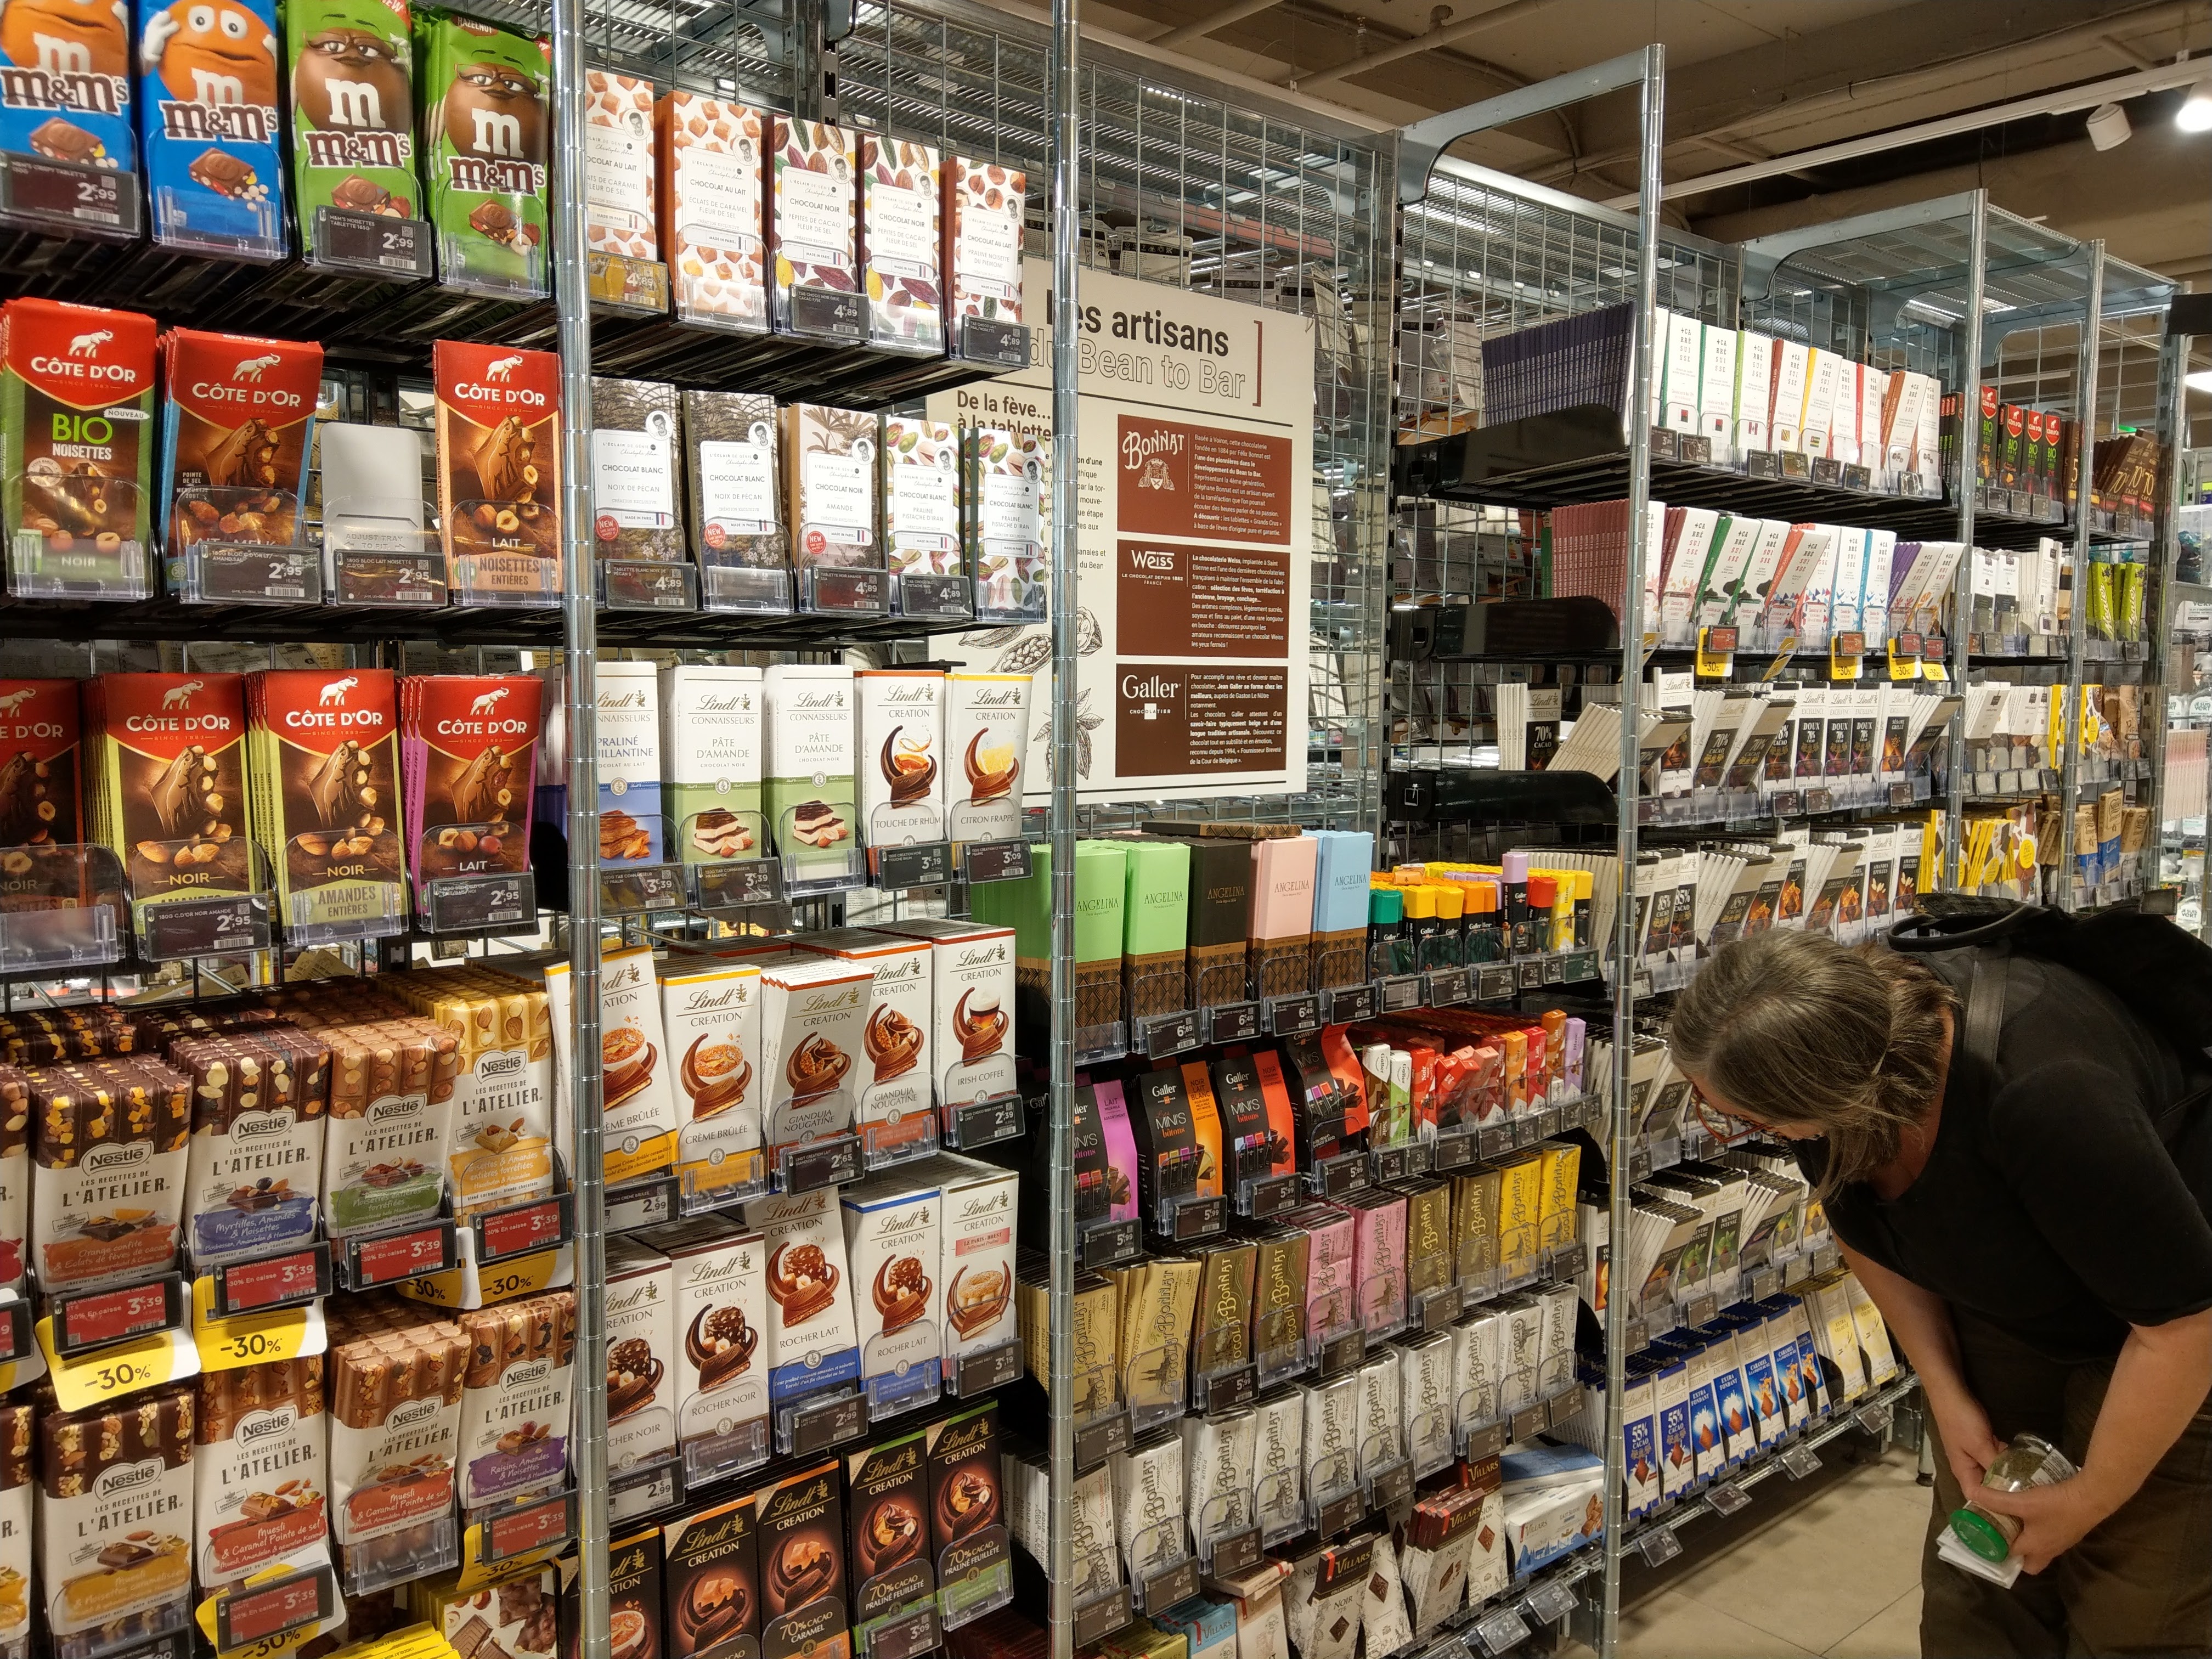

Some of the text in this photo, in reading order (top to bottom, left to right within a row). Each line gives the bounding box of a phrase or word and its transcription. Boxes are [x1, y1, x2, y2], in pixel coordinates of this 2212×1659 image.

[457, 16, 493, 33] HAZELNUT
[690, 178, 722, 191] CHOCOLAT
[732, 187, 746, 196] LAIT
[689, 195, 710, 206] ÉCLATS
[721, 200, 747, 213] CARAMEL
[790, 198, 840, 213] CHOCOLAT NOIR
[330, 221, 358, 230] TABLETTE
[348, 217, 375, 226] NOISETTES
[1113, 310, 1228, 357] artisans
[31, 357, 84, 377] CÔTE
[1078, 338, 1245, 399] Bean to Bar
[455, 383, 500, 402] CÔTE
[957, 391, 978, 408] De
[984, 393, 997, 412] la
[108, 409, 144, 419] NOUVEAU
[53, 414, 112, 443] BIO
[53, 443, 112, 459] NOISETTES
[1122, 430, 1184, 470] BONNAT
[1214, 437, 1228, 445] Voiron,
[1241, 440, 1267, 449] chocolaterie
[2008, 438, 2017, 453] BIO
[602, 465, 640, 473] CHOCOLAT
[639, 483, 659, 492] PÉCAN
[599, 521, 614, 529] NEW
[493, 538, 521, 548] LAIT
[480, 557, 538, 573] NOISETTES
[1131, 550, 1175, 569] Weiss
[492, 573, 528, 586] ENTIÈRES
[1122, 675, 1178, 698] Galler
[697, 694, 739, 710] Lindt
[286, 709, 335, 726] CÔTE
[692, 716, 754, 725] CONNAISSEURS
[889, 709, 930, 718] CREATION
[1803, 723, 1820, 731] DOUX
[712, 737, 735, 747] PÂTE
[697, 749, 749, 758] D'AMANDE
[875, 820, 907, 828] TOUCHE
[919, 817, 941, 826] RHUM
[961, 813, 1014, 825] CITRON FRAPPÉ
[327, 866, 364, 877] NOIR
[459, 861, 487, 872] LAIT
[1274, 880, 1310, 893] ANGELINA
[318, 887, 376, 905] AMANDES
[1144, 891, 1184, 905] ANGELINA
[328, 902, 368, 916] ENTIÈRES
[957, 1069, 1005, 1086] IRISH COFFEE
[1152, 1085, 1177, 1097] Galler
[1155, 1113, 1186, 1130] MINI'S
[686, 1124, 748, 1144] CRÈME BRÛLÉE
[1163, 1126, 1185, 1138] bâtons
[90, 1149, 144, 1166] Nestlé
[99, 1173, 136, 1184] RECETTES
[63, 1177, 165, 1206] L'ATELIER
[216, 1212, 295, 1233] Myrtilles, Amandes
[230, 1223, 279, 1238] & Noisettes
[878, 1336, 927, 1357] ROCHER LAIT
[1719, 1381, 1737, 1392] FONDANT
[1720, 1376, 1737, 1386] EXTRA
[692, 1391, 756, 1417] ROCHER NOIR
[1668, 1409, 1683, 1426] 55%
[1669, 1425, 1684, 1435] CACAO
[1468, 1460, 1499, 1481] VILLARS
[258, 1521, 286, 1538] Muesli
[222, 1519, 320, 1560] & Caramel Pointe de sel
[1335, 1550, 1371, 1573] VILLARS
[1333, 1595, 1353, 1610] NOIR
[780, 1611, 833, 1640] 70% CACAO
[791, 1624, 825, 1643] CARAMEL
